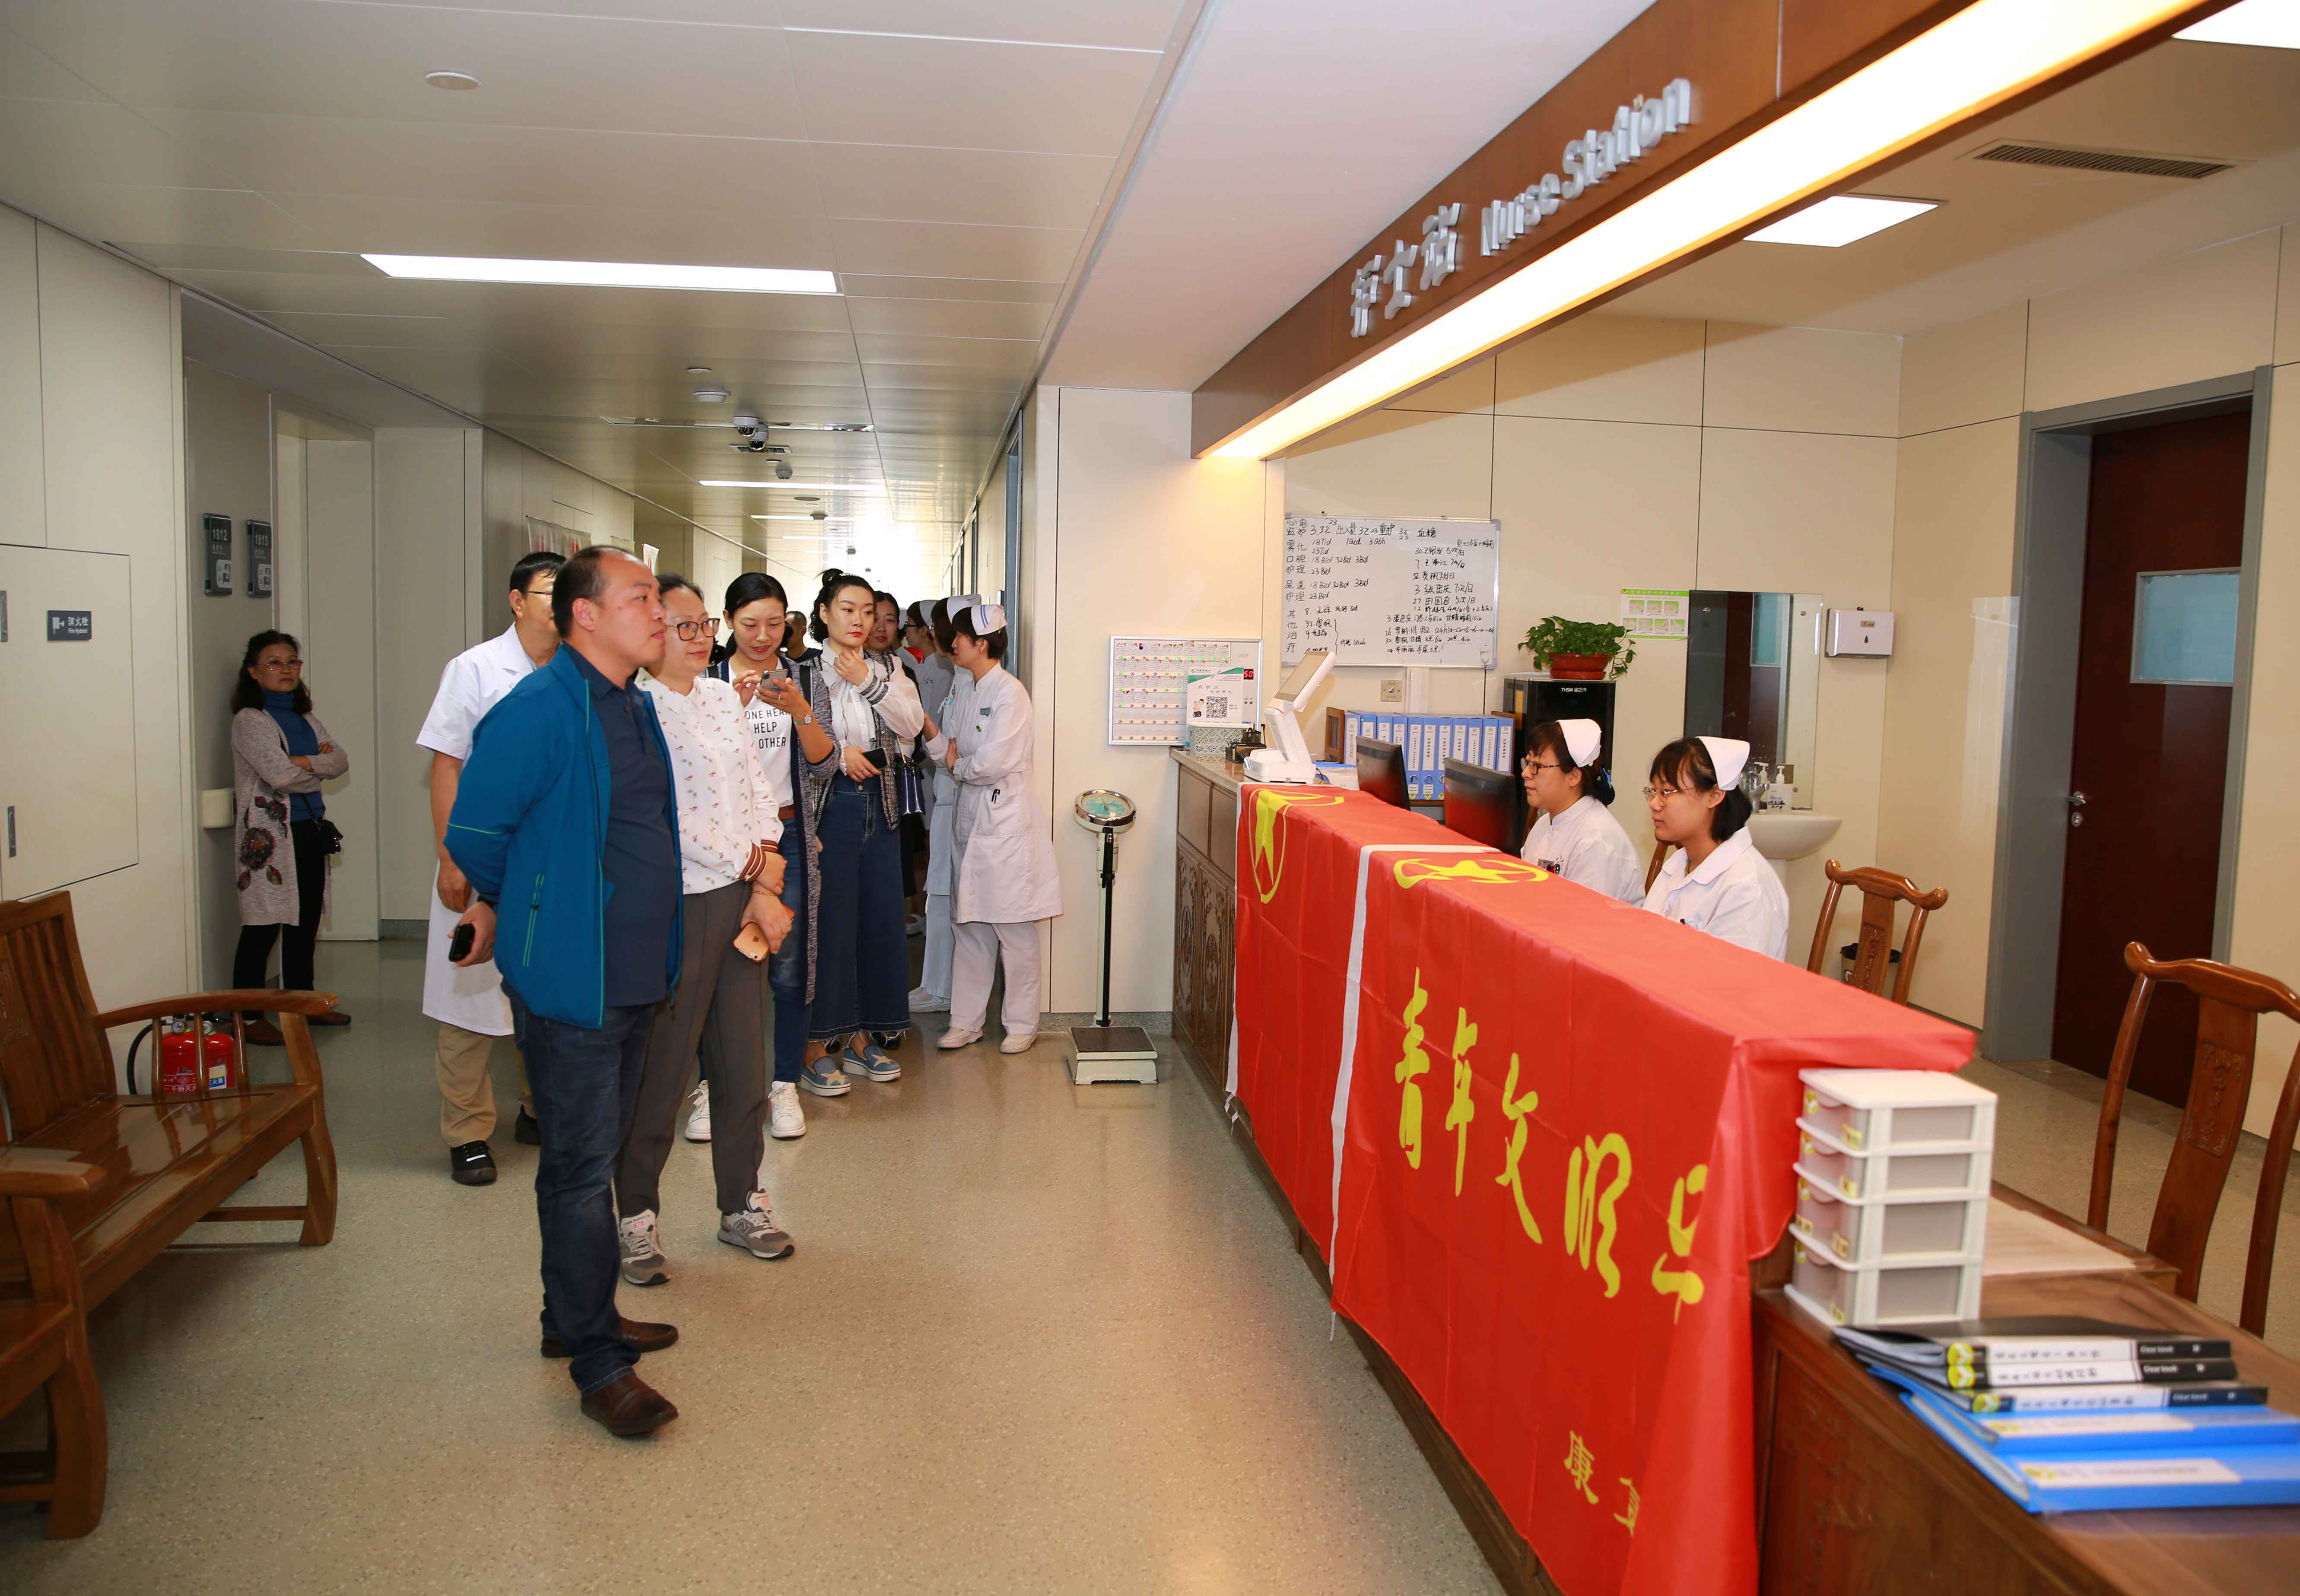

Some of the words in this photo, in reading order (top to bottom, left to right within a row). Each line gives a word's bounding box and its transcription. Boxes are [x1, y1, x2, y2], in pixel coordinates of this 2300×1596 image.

[1480, 173, 1561, 256] Nurse
[1562, 77, 1691, 200] Station
[212, 529, 228, 541] 1812
[1286, 527, 1306, 536] 监护
[1336, 523, 1357, 535] 出入量
[1417, 527, 1437, 538] 血糖
[1287, 540, 1306, 553] 雾化
[1286, 565, 1306, 574] 护理
[1284, 580, 1306, 590] 尿道
[1285, 591, 1305, 603] 护理
[68, 616, 89, 626] 消火栓
[754, 722, 777, 733] HELP
[759, 737, 786, 749] OTHER
